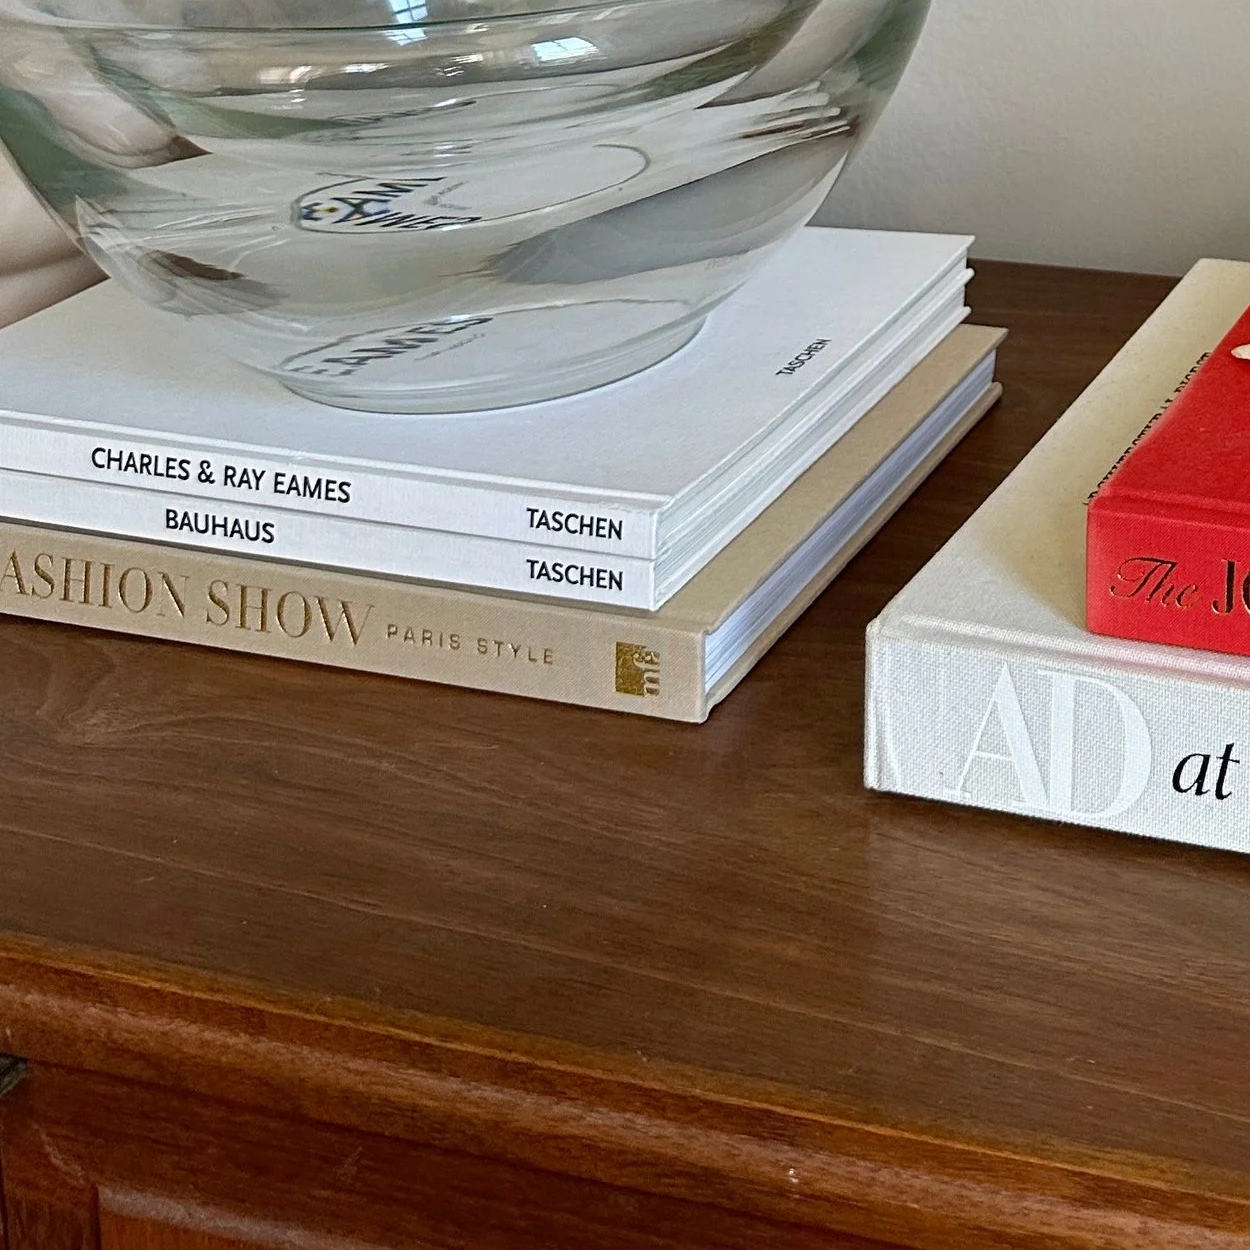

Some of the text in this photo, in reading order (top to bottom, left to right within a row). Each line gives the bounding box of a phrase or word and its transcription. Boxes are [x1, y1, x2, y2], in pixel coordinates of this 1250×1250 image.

[775, 338, 833, 375] TASCHEN
[91, 446, 352, 503] CHARLES & RAY EAMES
[165, 508, 276, 544] BAUHAUS
[526, 507, 624, 541] TASCHEN
[526, 559, 624, 591] TASCHEN
[1109, 556, 1200, 609] The
[205, 579, 375, 647] SHOW
[386, 623, 462, 651] PARIS
[477, 637, 555, 666] STYLE
[944, 661, 1153, 820] AD
[1171, 741, 1242, 801] at
